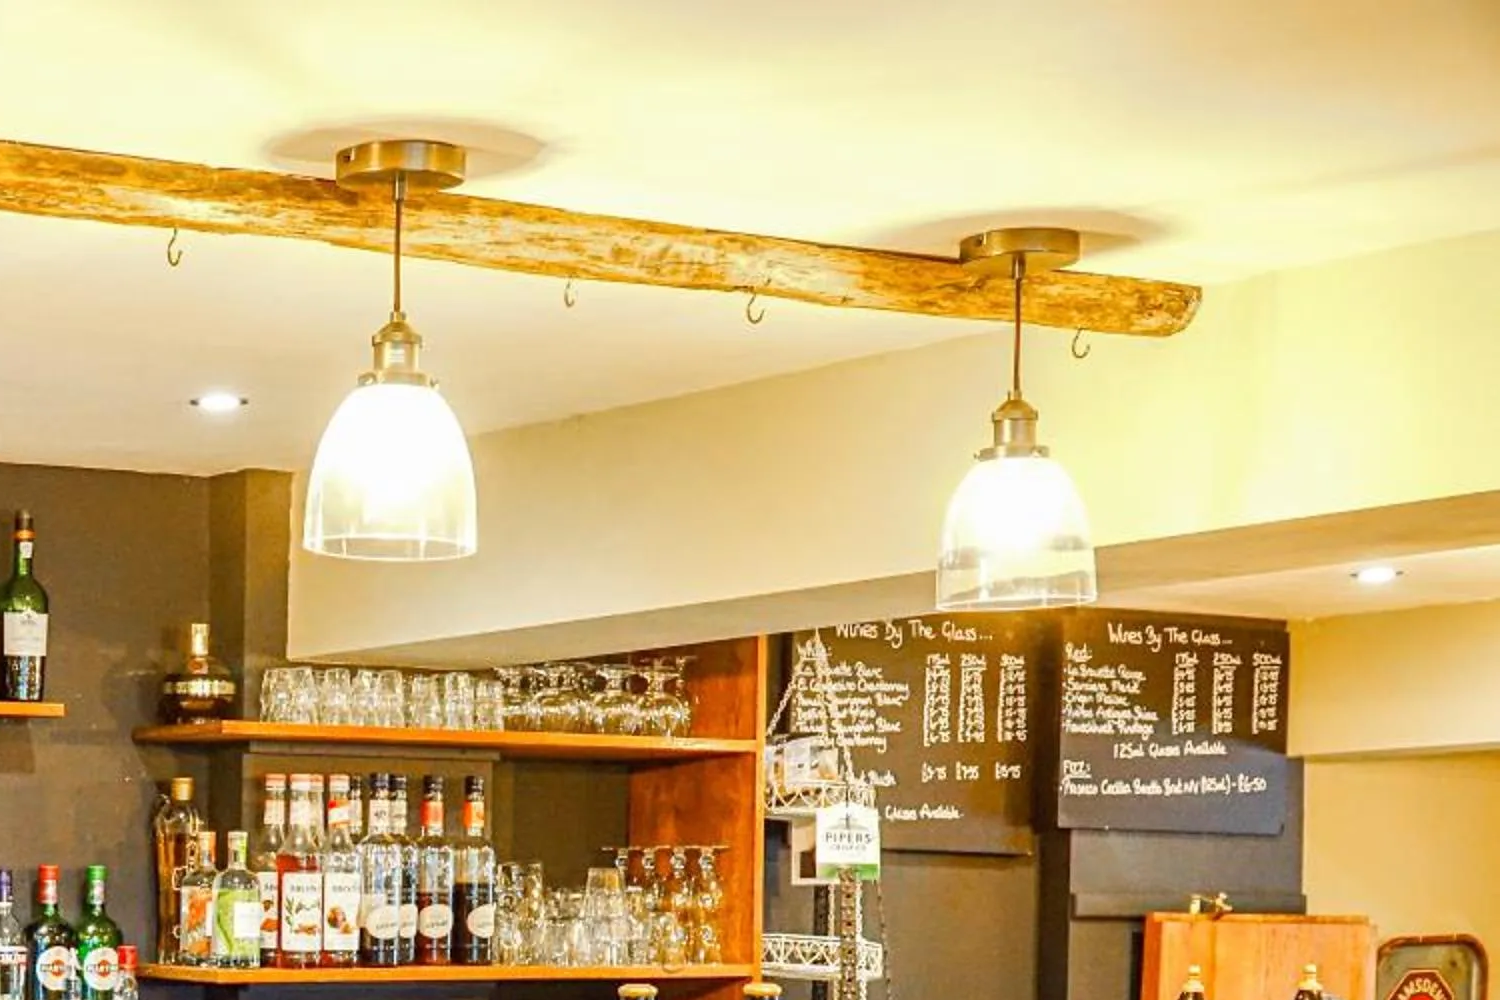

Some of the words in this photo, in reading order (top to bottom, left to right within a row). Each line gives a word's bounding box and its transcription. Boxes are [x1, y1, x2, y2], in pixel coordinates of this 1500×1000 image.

[908, 619, 937, 640] The
[1145, 625, 1162, 652] By
[1163, 627, 1188, 645] The
[825, 832, 873, 844] PIPERS
